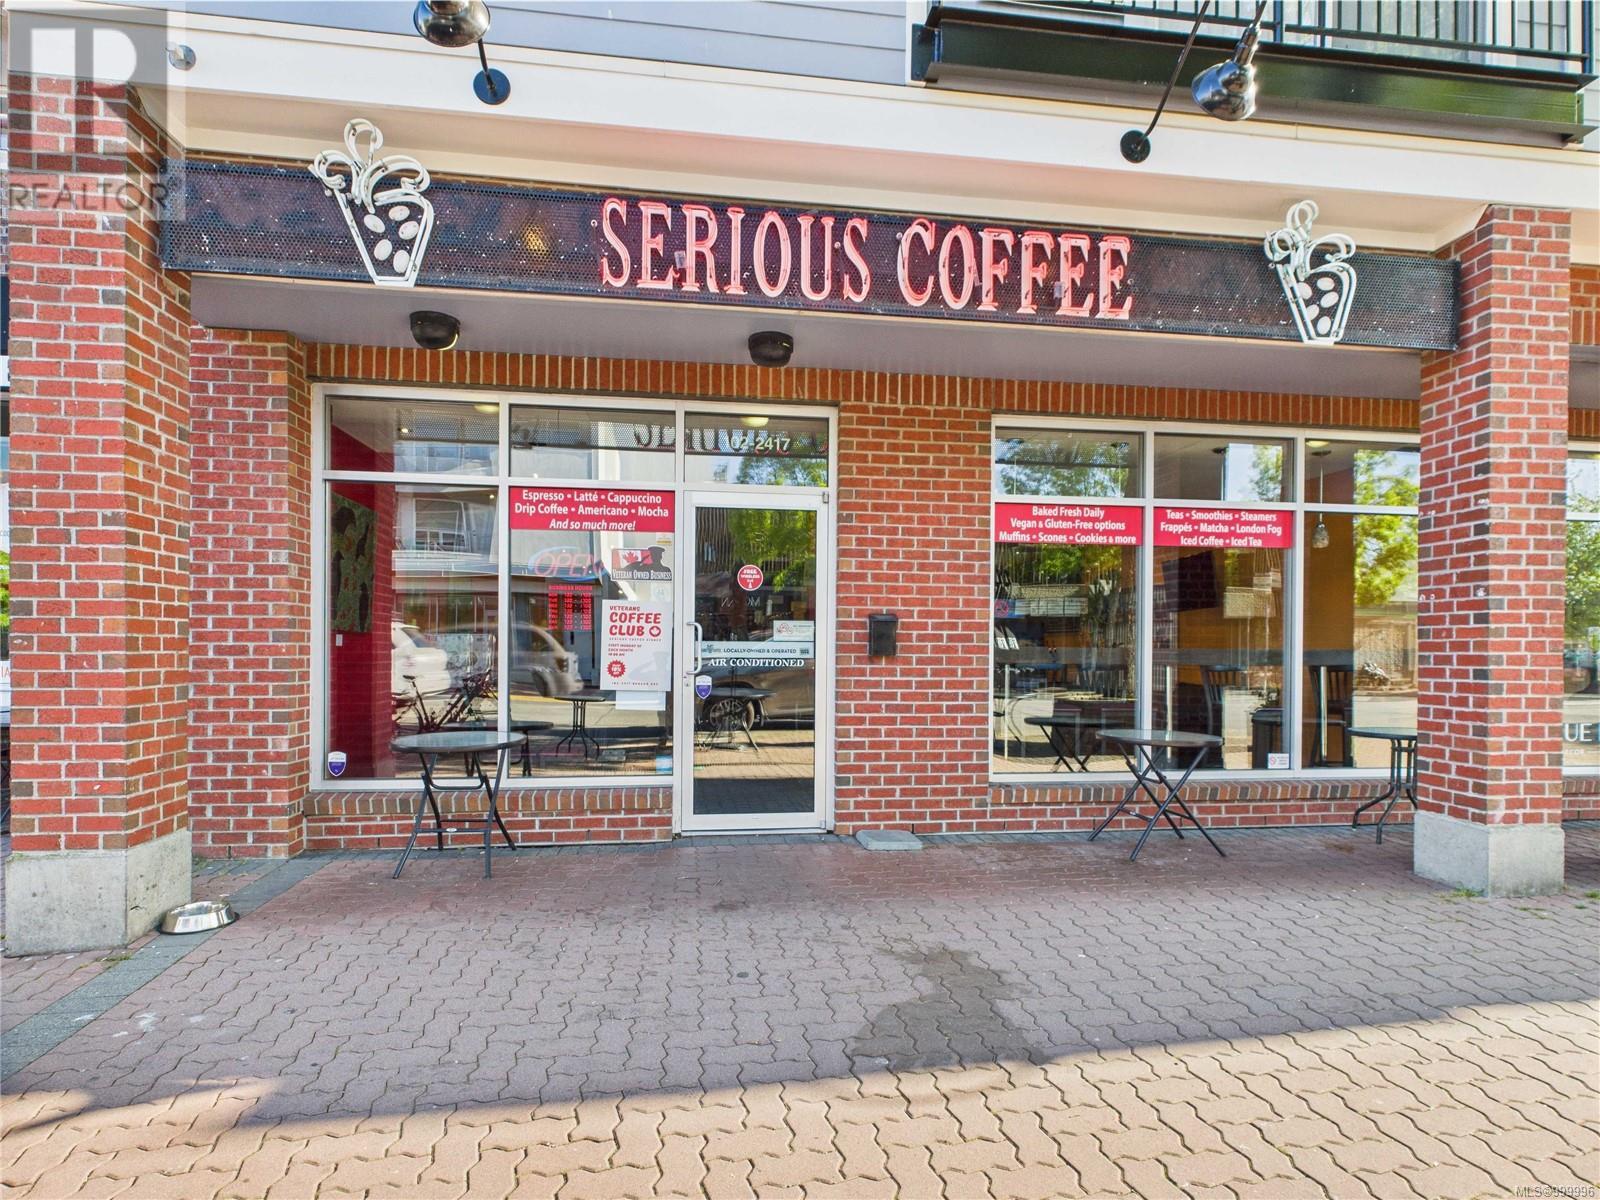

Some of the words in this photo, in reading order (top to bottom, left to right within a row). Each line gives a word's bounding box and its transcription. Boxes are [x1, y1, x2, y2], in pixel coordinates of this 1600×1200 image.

[600, 197, 871, 303] SERIOUS
[897, 218, 1135, 321] COFFEE
[522, 489, 564, 502] Espresso
[574, 490, 598, 502] Latté
[607, 492, 662, 505] Cappuccino
[514, 502, 536, 516] Drip
[537, 503, 568, 515] Coffee
[578, 504, 628, 516] Americano
[638, 506, 669, 517] Mocha
[1032, 505, 1058, 516] Baked
[1059, 506, 1082, 517] Fresh
[1083, 507, 1105, 520] Daily
[1166, 509, 1184, 520] Teas
[1191, 510, 1233, 521] Smoothies
[1241, 511, 1277, 522] Steamers
[549, 518, 569, 529] And
[569, 521, 581, 530] so
[582, 519, 607, 531] much
[608, 520, 636, 532] more!
[1010, 517, 1037, 530] Vegan
[1044, 518, 1093, 530] Gluten-Free
[1094, 520, 1126, 532] options
[1199, 522, 1229, 533] Matcha
[1236, 523, 1266, 534] London
[1267, 524, 1283, 537] Fog
[999, 531, 1031, 542] Muffins
[1038, 532, 1067, 543] Scones
[1075, 533, 1107, 543] Cookies
[1114, 536, 1136, 544] more
[1180, 535, 1198, 546] Iced
[1199, 536, 1224, 547] Coffee
[1231, 536, 1248, 547] Iced
[1248, 536, 1263, 547] Tea
[534, 551, 605, 577] OPEN
[609, 611, 662, 624] COFFEE
[609, 624, 645, 637] CLUB
[709, 658, 729, 667] AIR
[729, 658, 805, 667] CONDITIONED
